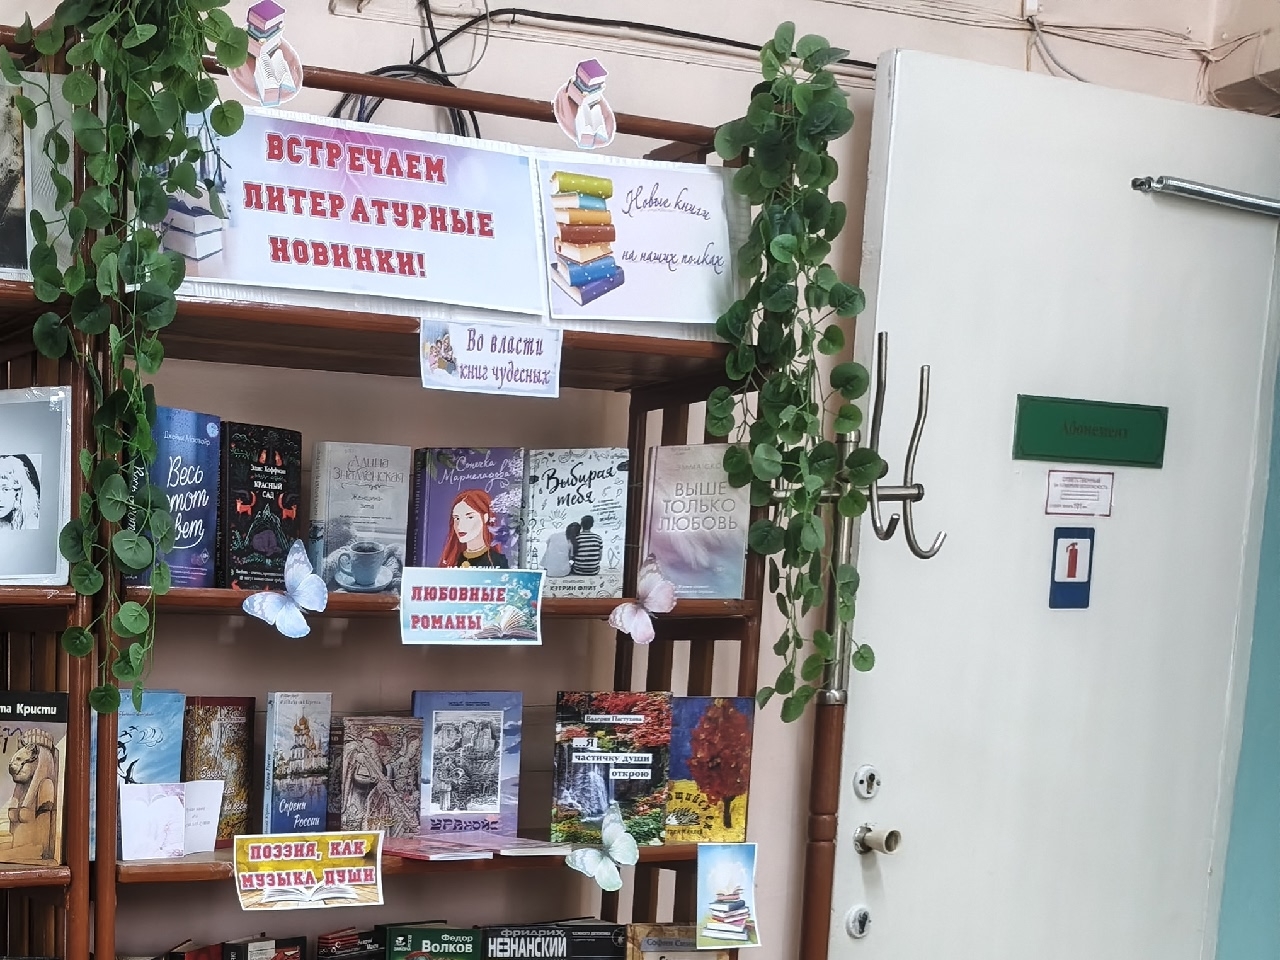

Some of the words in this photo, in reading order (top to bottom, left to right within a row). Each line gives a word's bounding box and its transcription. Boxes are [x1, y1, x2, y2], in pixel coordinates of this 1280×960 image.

[265, 131, 447, 185] ВСТРЕЧАЕМ
[242, 181, 495, 239] ЛИТЕРАТУРНЫЕ
[622, 182, 671, 217] Новые
[674, 188, 711, 220] книги
[268, 235, 427, 278] НОВИНКИ!
[622, 250, 637, 262] на
[640, 251, 678, 271] наших
[681, 241, 725, 275] полках
[467, 328, 484, 352] Во
[490, 333, 544, 356] власти
[459, 363, 488, 383] книг
[491, 364, 551, 389] чудесных
[167, 456, 204, 488] Весь
[542, 461, 618, 495] Выбирая
[557, 484, 596, 507] тебя
[675, 481, 728, 497] ВЫШЕ
[662, 499, 736, 515] ТОЛЬКО
[657, 516, 738, 532] ЛЮБОВЬ
[410, 586, 506, 602] ЛЮБОВНЫЕ
[410, 614, 482, 630] РОМАНЫ
[16, 704, 57, 716] Кристи
[575, 754, 620, 764] частичку
[622, 754, 650, 764] души
[611, 769, 650, 780] открою
[250, 842, 321, 861] ПОЭЗИЯ,
[330, 840, 366, 856] КАК
[241, 871, 317, 889] МУЗЫКА
[323, 868, 375, 886] ДУШИ
[421, 939, 473, 953] Волков
[441, 933, 473, 942] Федор
[488, 936, 567, 958] НЕЗНАНСКИЙ
